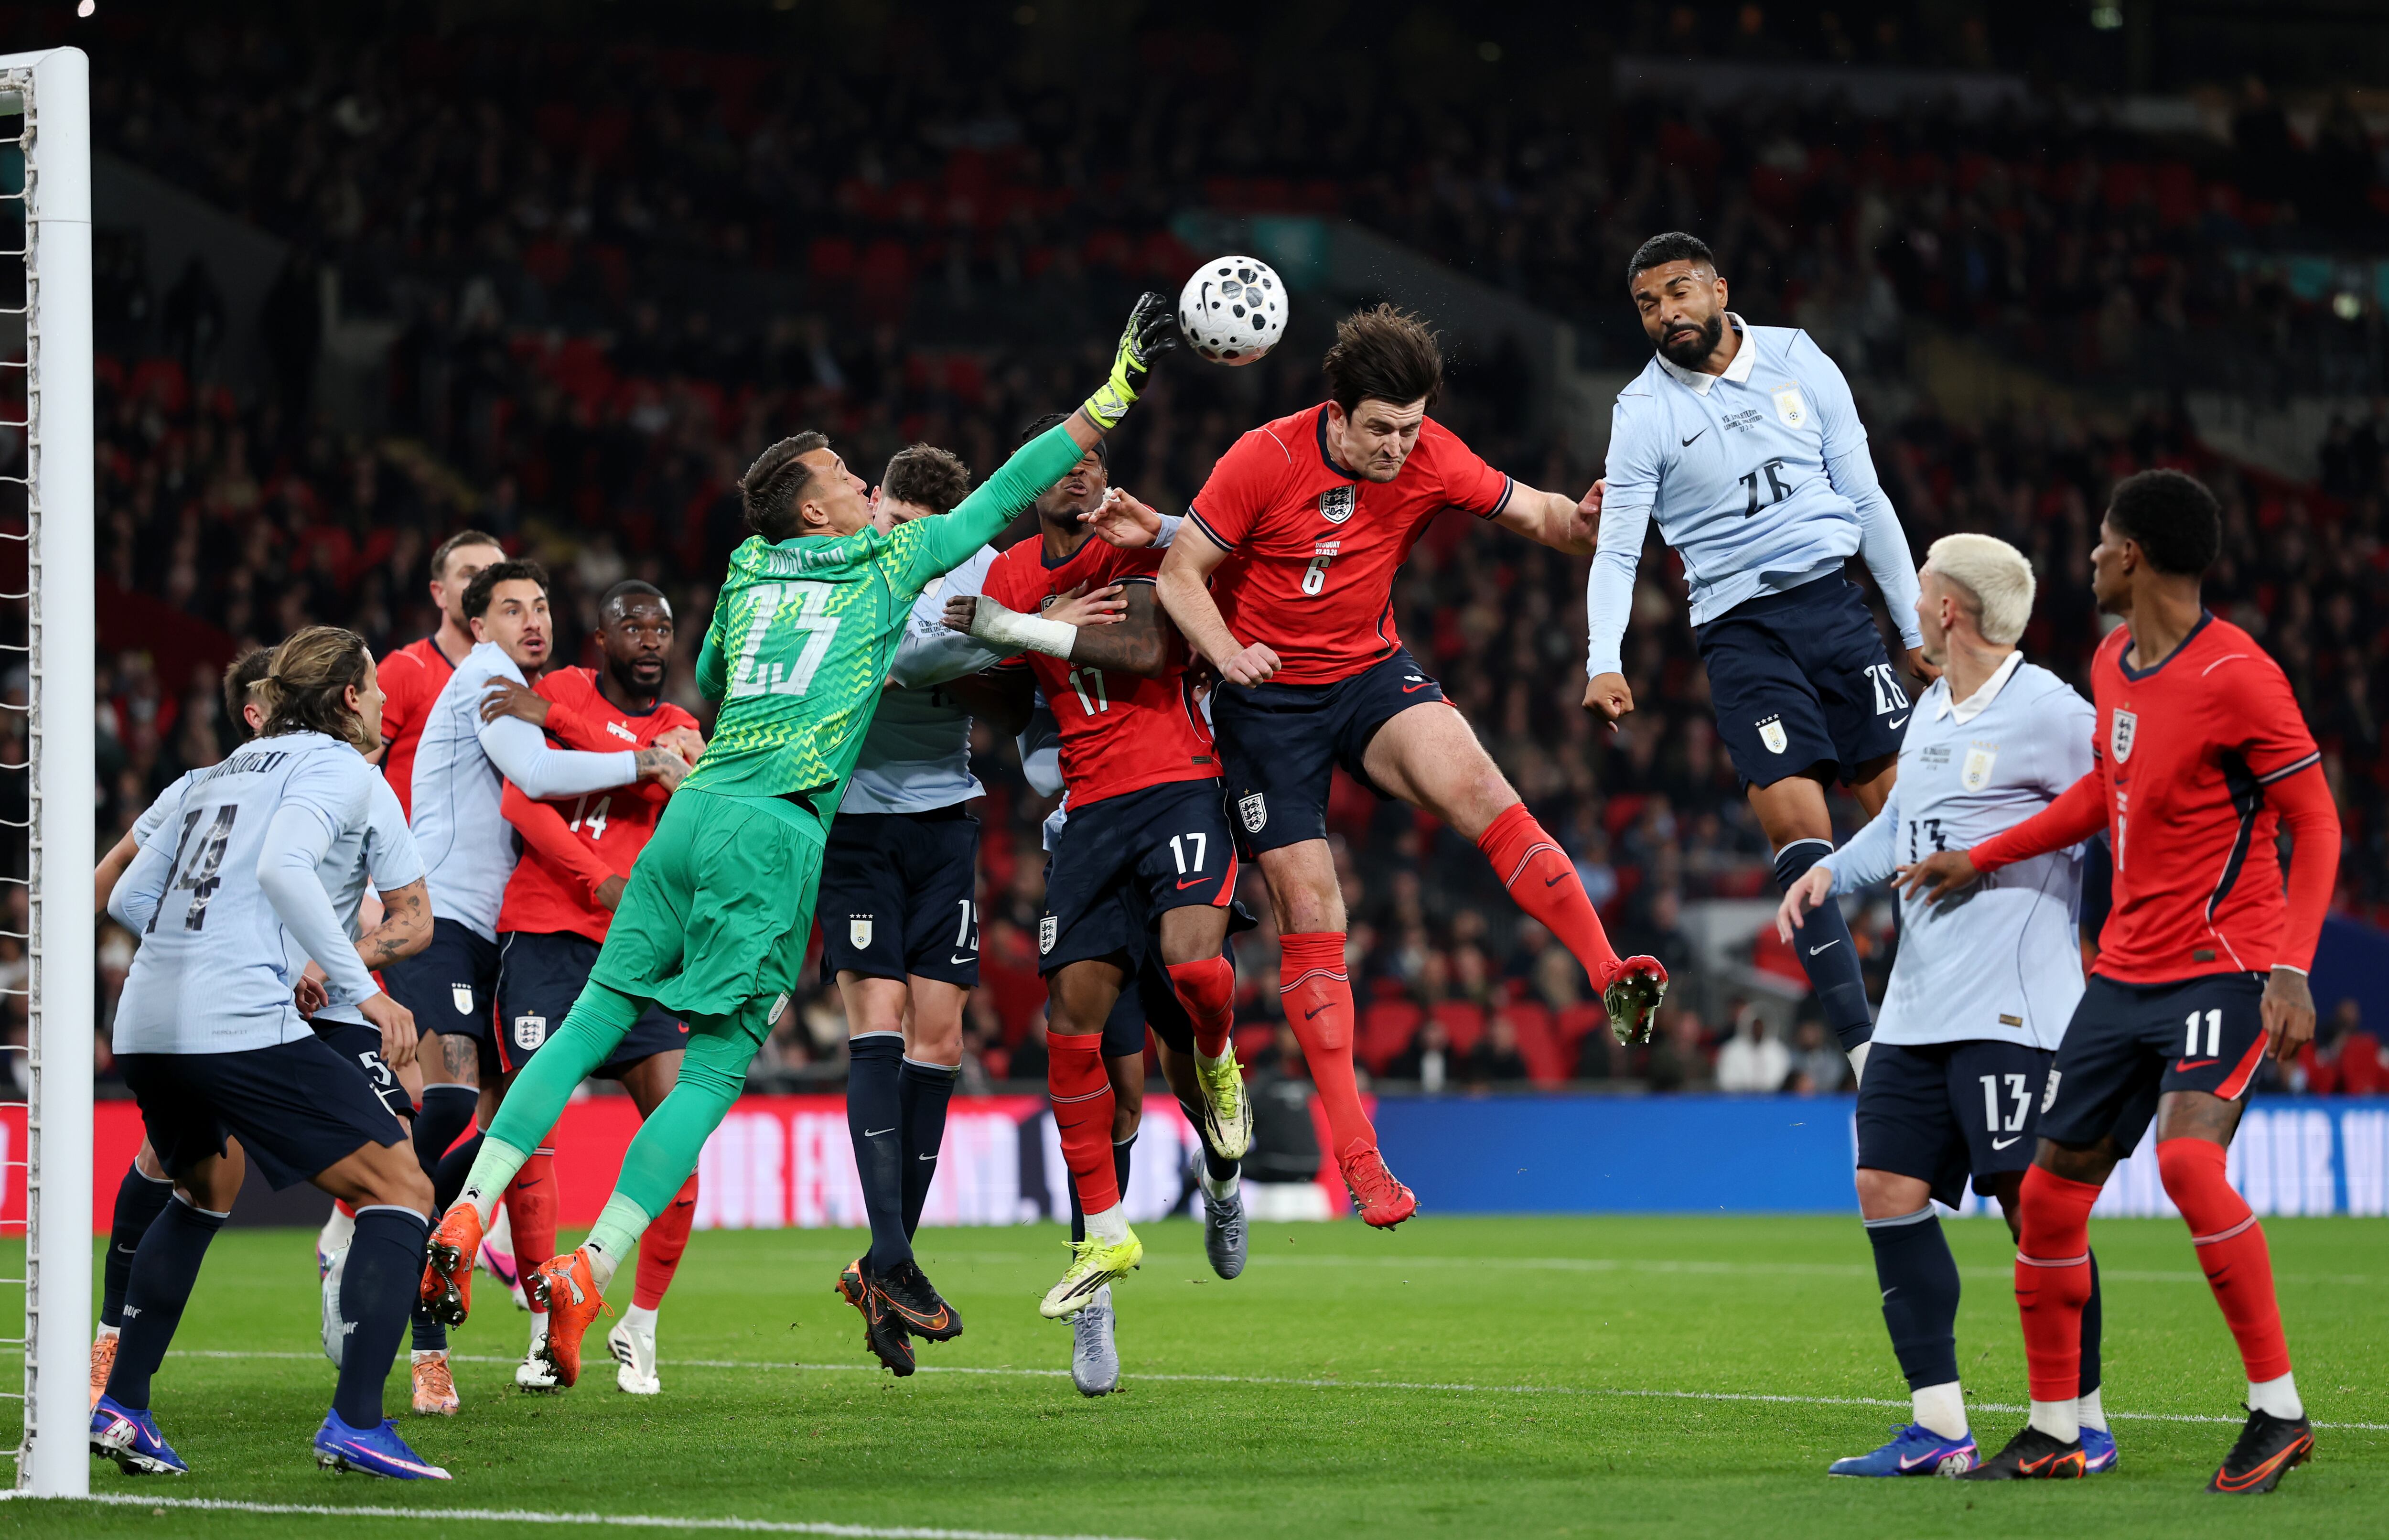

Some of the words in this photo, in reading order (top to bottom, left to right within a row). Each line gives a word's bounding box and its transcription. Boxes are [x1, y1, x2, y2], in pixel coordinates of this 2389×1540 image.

[1301, 556, 1331, 596] 6
[731, 581, 842, 697] 23
[1068, 667, 1108, 717] 17
[1863, 663, 1909, 716] 26
[569, 793, 612, 840] 14
[145, 804, 238, 934] 14
[1169, 832, 1206, 875] 17
[2185, 1009, 2222, 1057] 11
[358, 1051, 392, 1086] 5
[1979, 1074, 2032, 1131] 13
